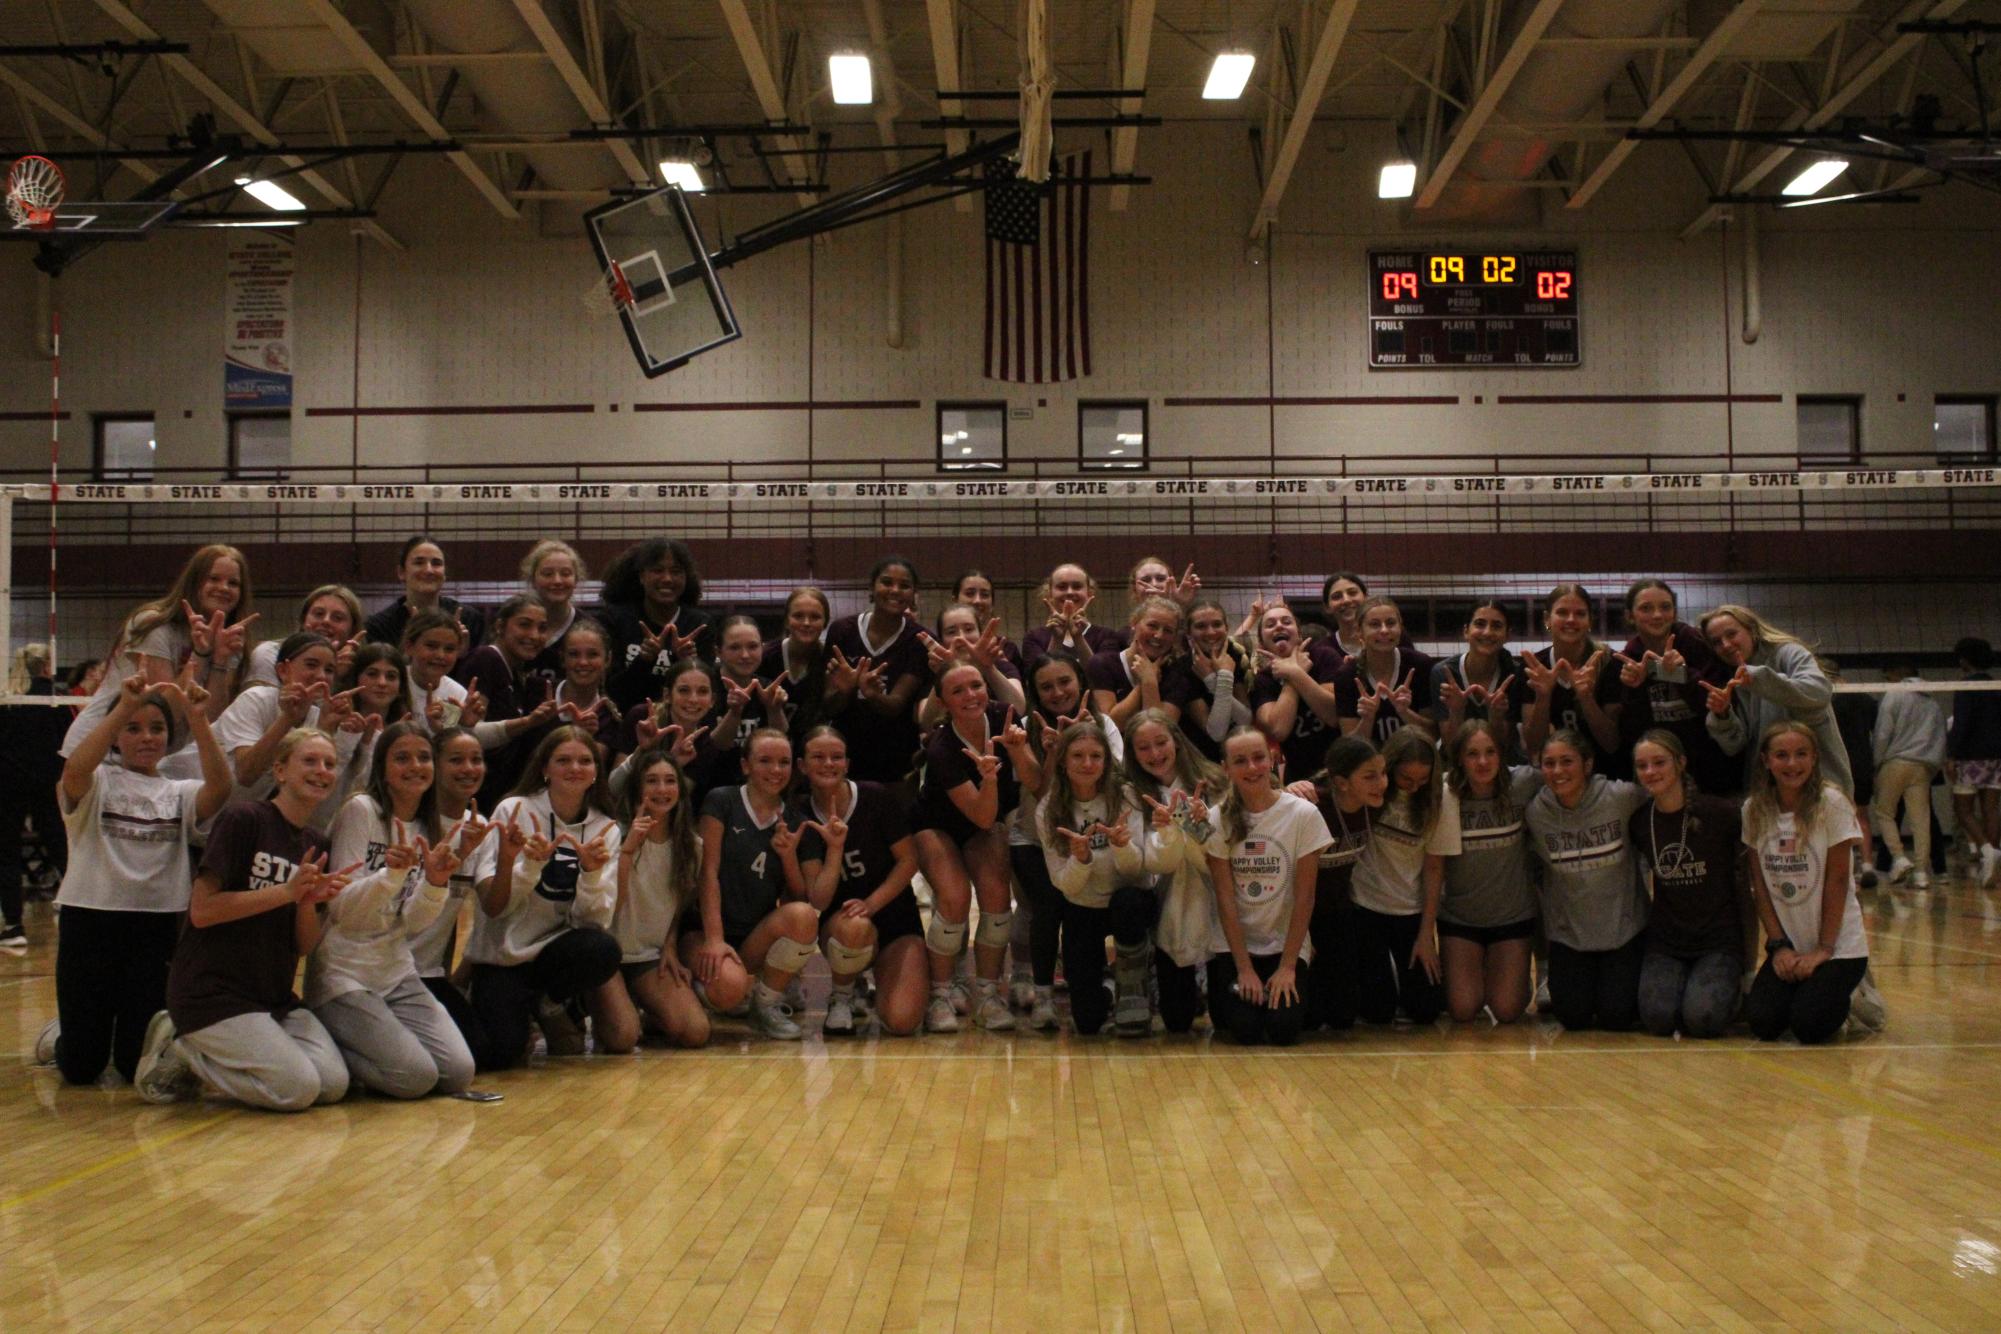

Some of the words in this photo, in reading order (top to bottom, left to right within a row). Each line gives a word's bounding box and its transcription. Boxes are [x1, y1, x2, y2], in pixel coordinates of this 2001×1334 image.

[1378, 255, 1413, 268] HOME
[1527, 254, 1574, 267] VISITOR
[1430, 256, 1464, 283] 09
[1482, 256, 1516, 283] 02
[1383, 272, 1419, 300] 09
[1537, 271, 1572, 299] 02
[1447, 297, 1480, 307] PERIOD
[1394, 304, 1424, 314] BONUS
[1524, 303, 1555, 313] BONUS
[1375, 320, 1404, 331] FOULS
[1442, 320, 1476, 330] PLAYER
[1486, 320, 1514, 330] FOULS
[1544, 320, 1572, 330] FOULS
[1378, 354, 1406, 363] POINTS
[1419, 354, 1435, 363] TOL
[1465, 353, 1493, 362] MATCH
[1515, 353, 1531, 362] TOL
[1545, 352, 1574, 362] POINTS
[77, 486, 125, 498] STATE
[172, 486, 221, 498] STATE
[268, 486, 317, 498] STATE
[364, 486, 414, 498] STATE
[462, 486, 511, 498] STATE
[560, 486, 609, 497] STATE
[658, 486, 708, 497] STATE
[757, 485, 807, 497] STATE
[856, 484, 907, 496] STATE
[956, 483, 1007, 495] STATE
[1056, 482, 1107, 495] STATE
[1156, 481, 1207, 494] STATE
[1256, 480, 1307, 493] STATE
[1355, 479, 1406, 492] STATE
[1455, 478, 1505, 491] STATE
[1553, 477, 1603, 490] STATE
[1652, 476, 1701, 488] STATE
[1749, 474, 1799, 487] STATE
[1847, 471, 1896, 484] STATE
[1944, 470, 1994, 483] STATE
[1545, 820, 1622, 852] STATE
[751, 851, 767, 880] 4
[1253, 856, 1281, 866] VOLLEY
